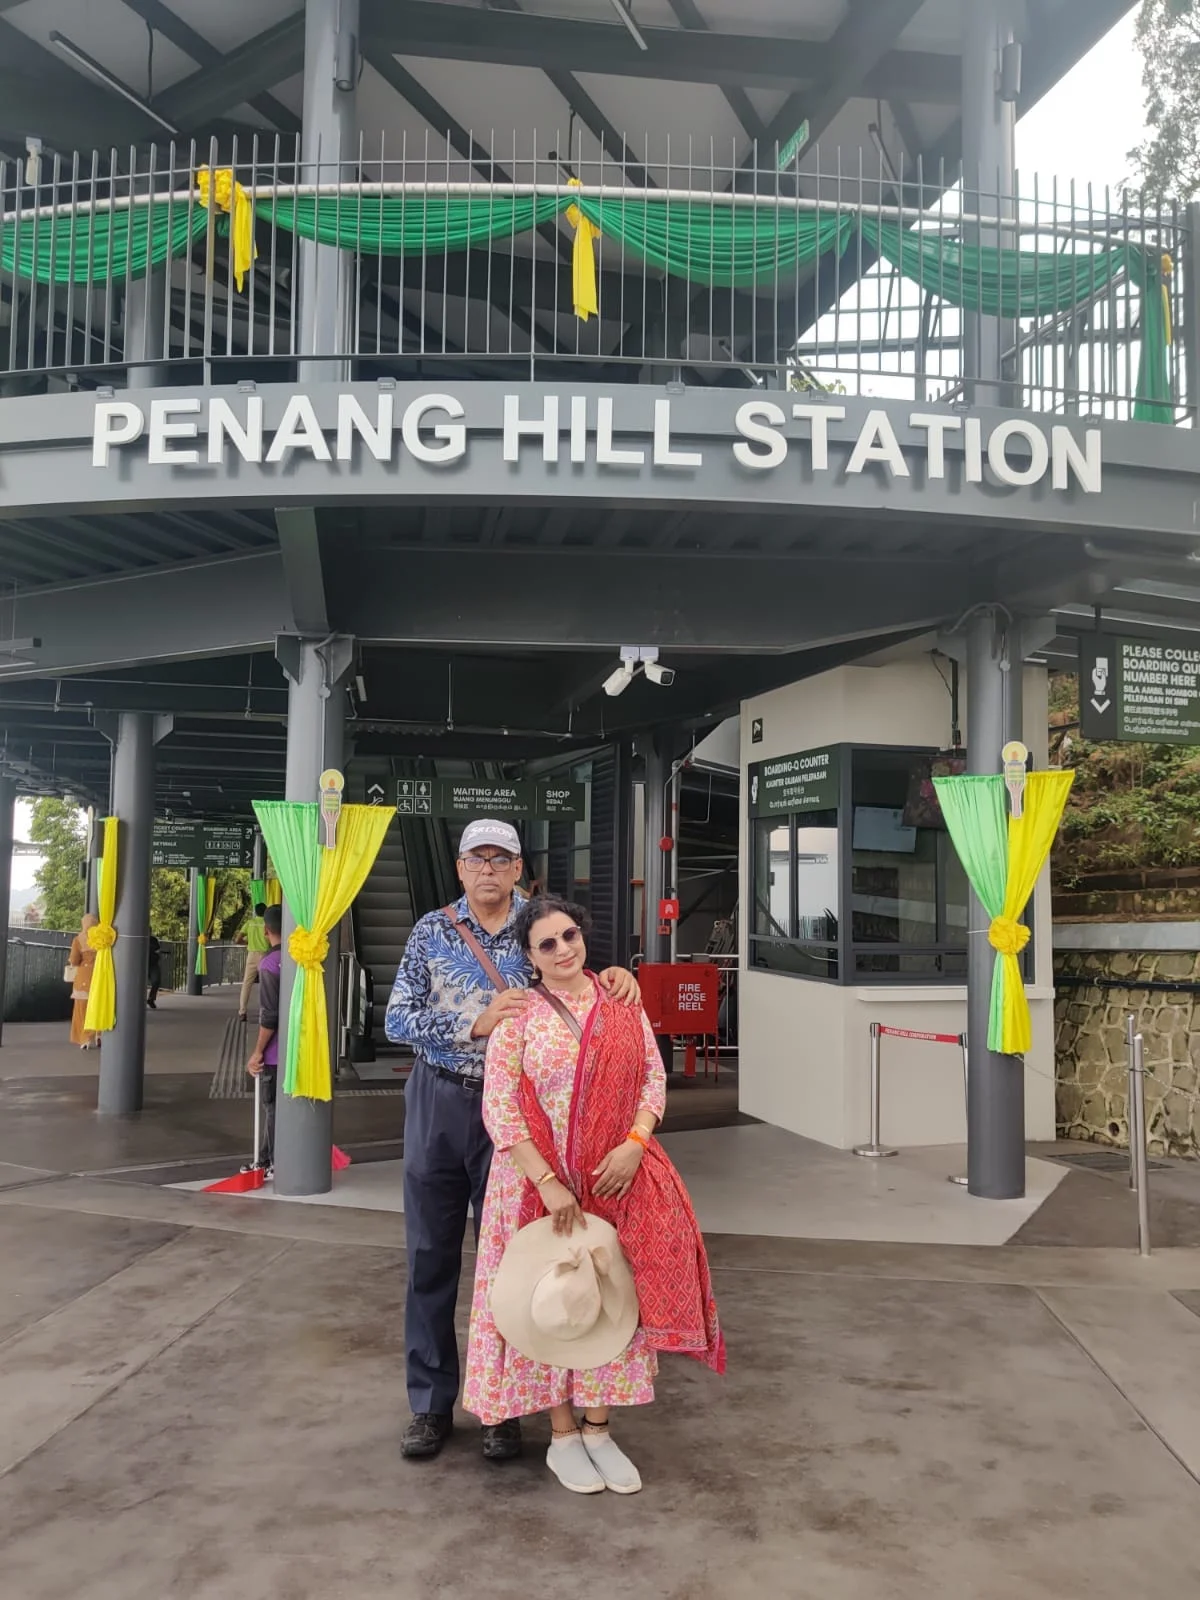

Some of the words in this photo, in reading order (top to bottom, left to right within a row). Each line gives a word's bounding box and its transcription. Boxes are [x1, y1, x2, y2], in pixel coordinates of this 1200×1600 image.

[92, 393, 466, 467] PENANG
[503, 395, 702, 465] HILL
[732, 401, 1102, 493] STATION
[1122, 644, 1162, 659] PLEASE
[1164, 648, 1200, 662] COLLE
[1122, 657, 1180, 673] BOARDING
[1123, 671, 1168, 685] NUMBER
[1170, 674, 1196, 687] HERE
[1123, 685, 1140, 694] SILA
[764, 760, 799, 776] BOARDING-Q
[799, 754, 829, 769] COUNTER
[453, 787, 491, 796] WAITING
[493, 789, 517, 798] AREA
[546, 790, 570, 799] SHOP
[678, 983, 701, 992] FIRE
[678, 993, 706, 1001] HOSE
[678, 1002, 704, 1011] REEL
